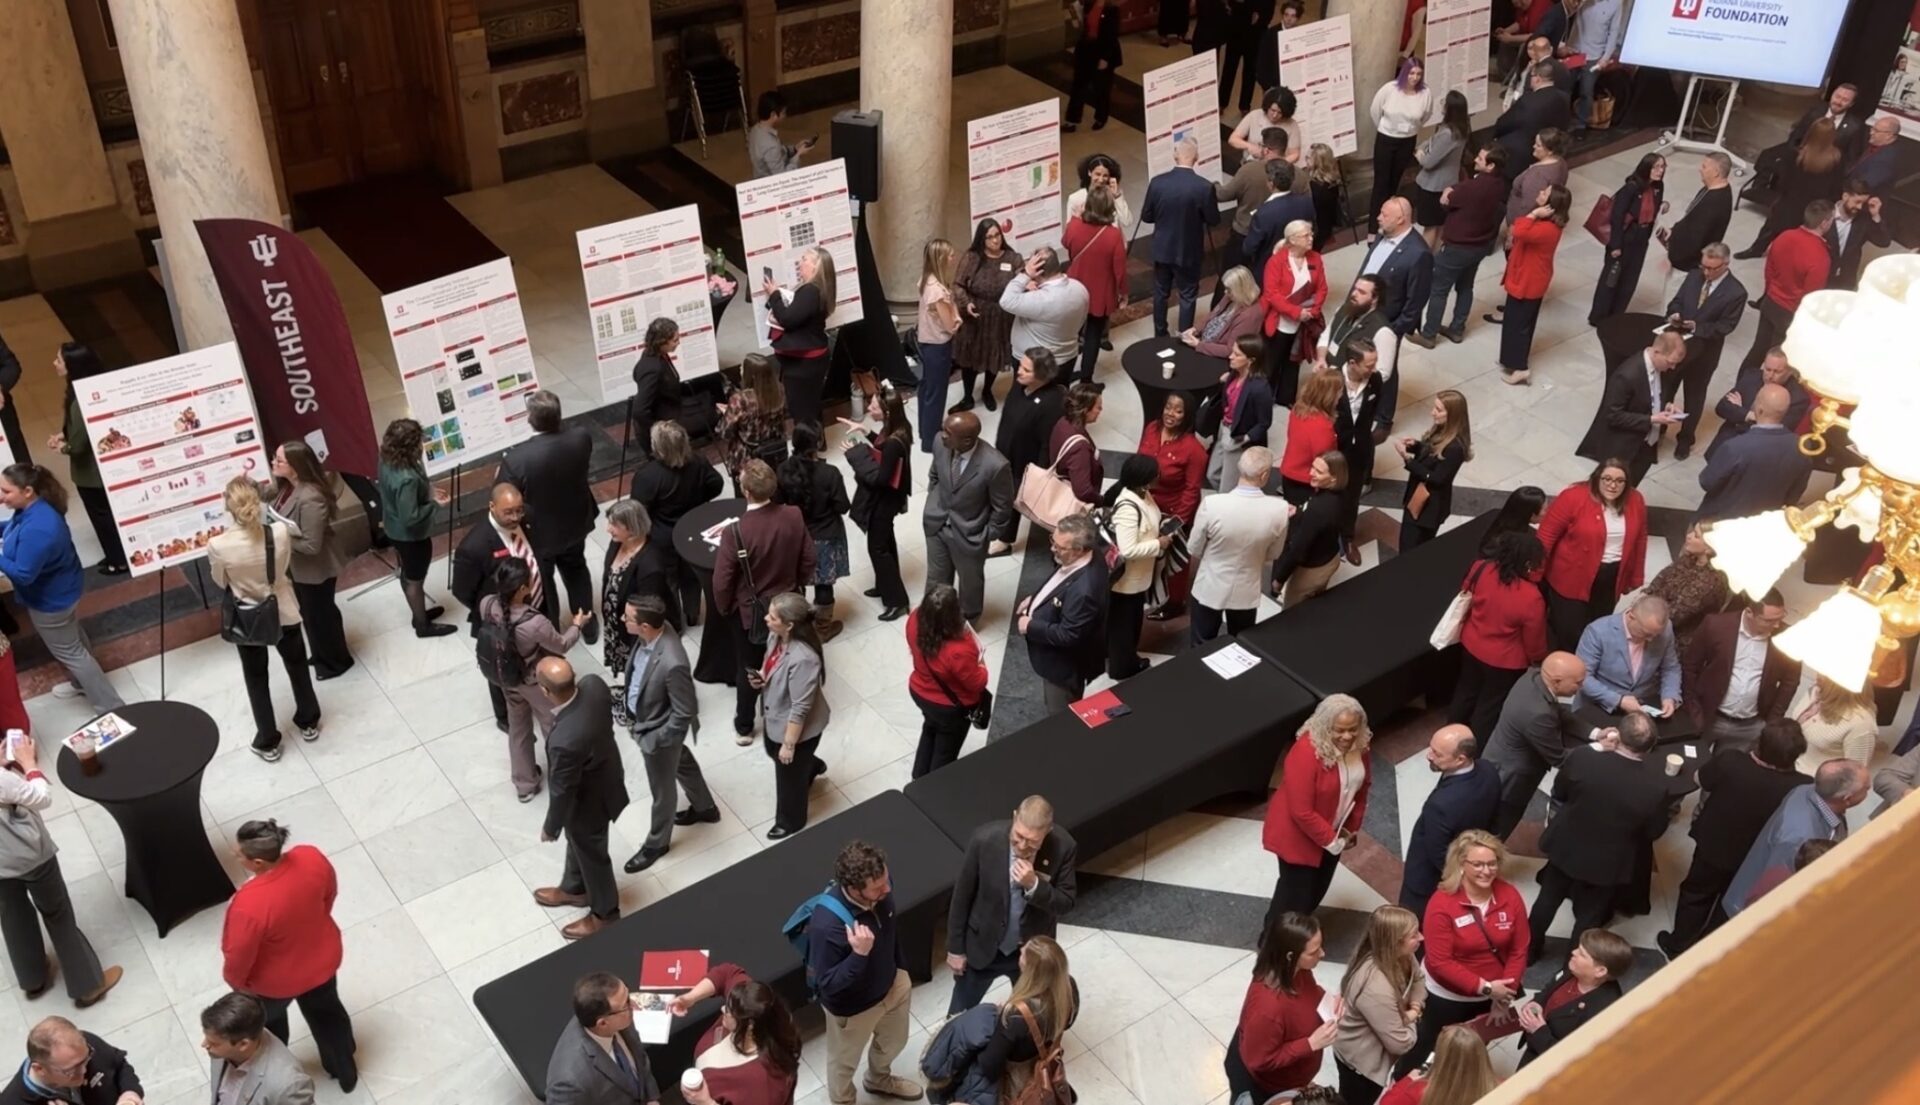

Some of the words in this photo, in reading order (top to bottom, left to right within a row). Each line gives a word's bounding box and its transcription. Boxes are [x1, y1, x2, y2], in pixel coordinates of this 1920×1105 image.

[1705, 6, 1789, 26] FOUNDATION
[1740, 0, 1783, 11] UNIVERSITY
[249, 234, 278, 267] IU
[261, 280, 319, 415] SOUTHEAST
